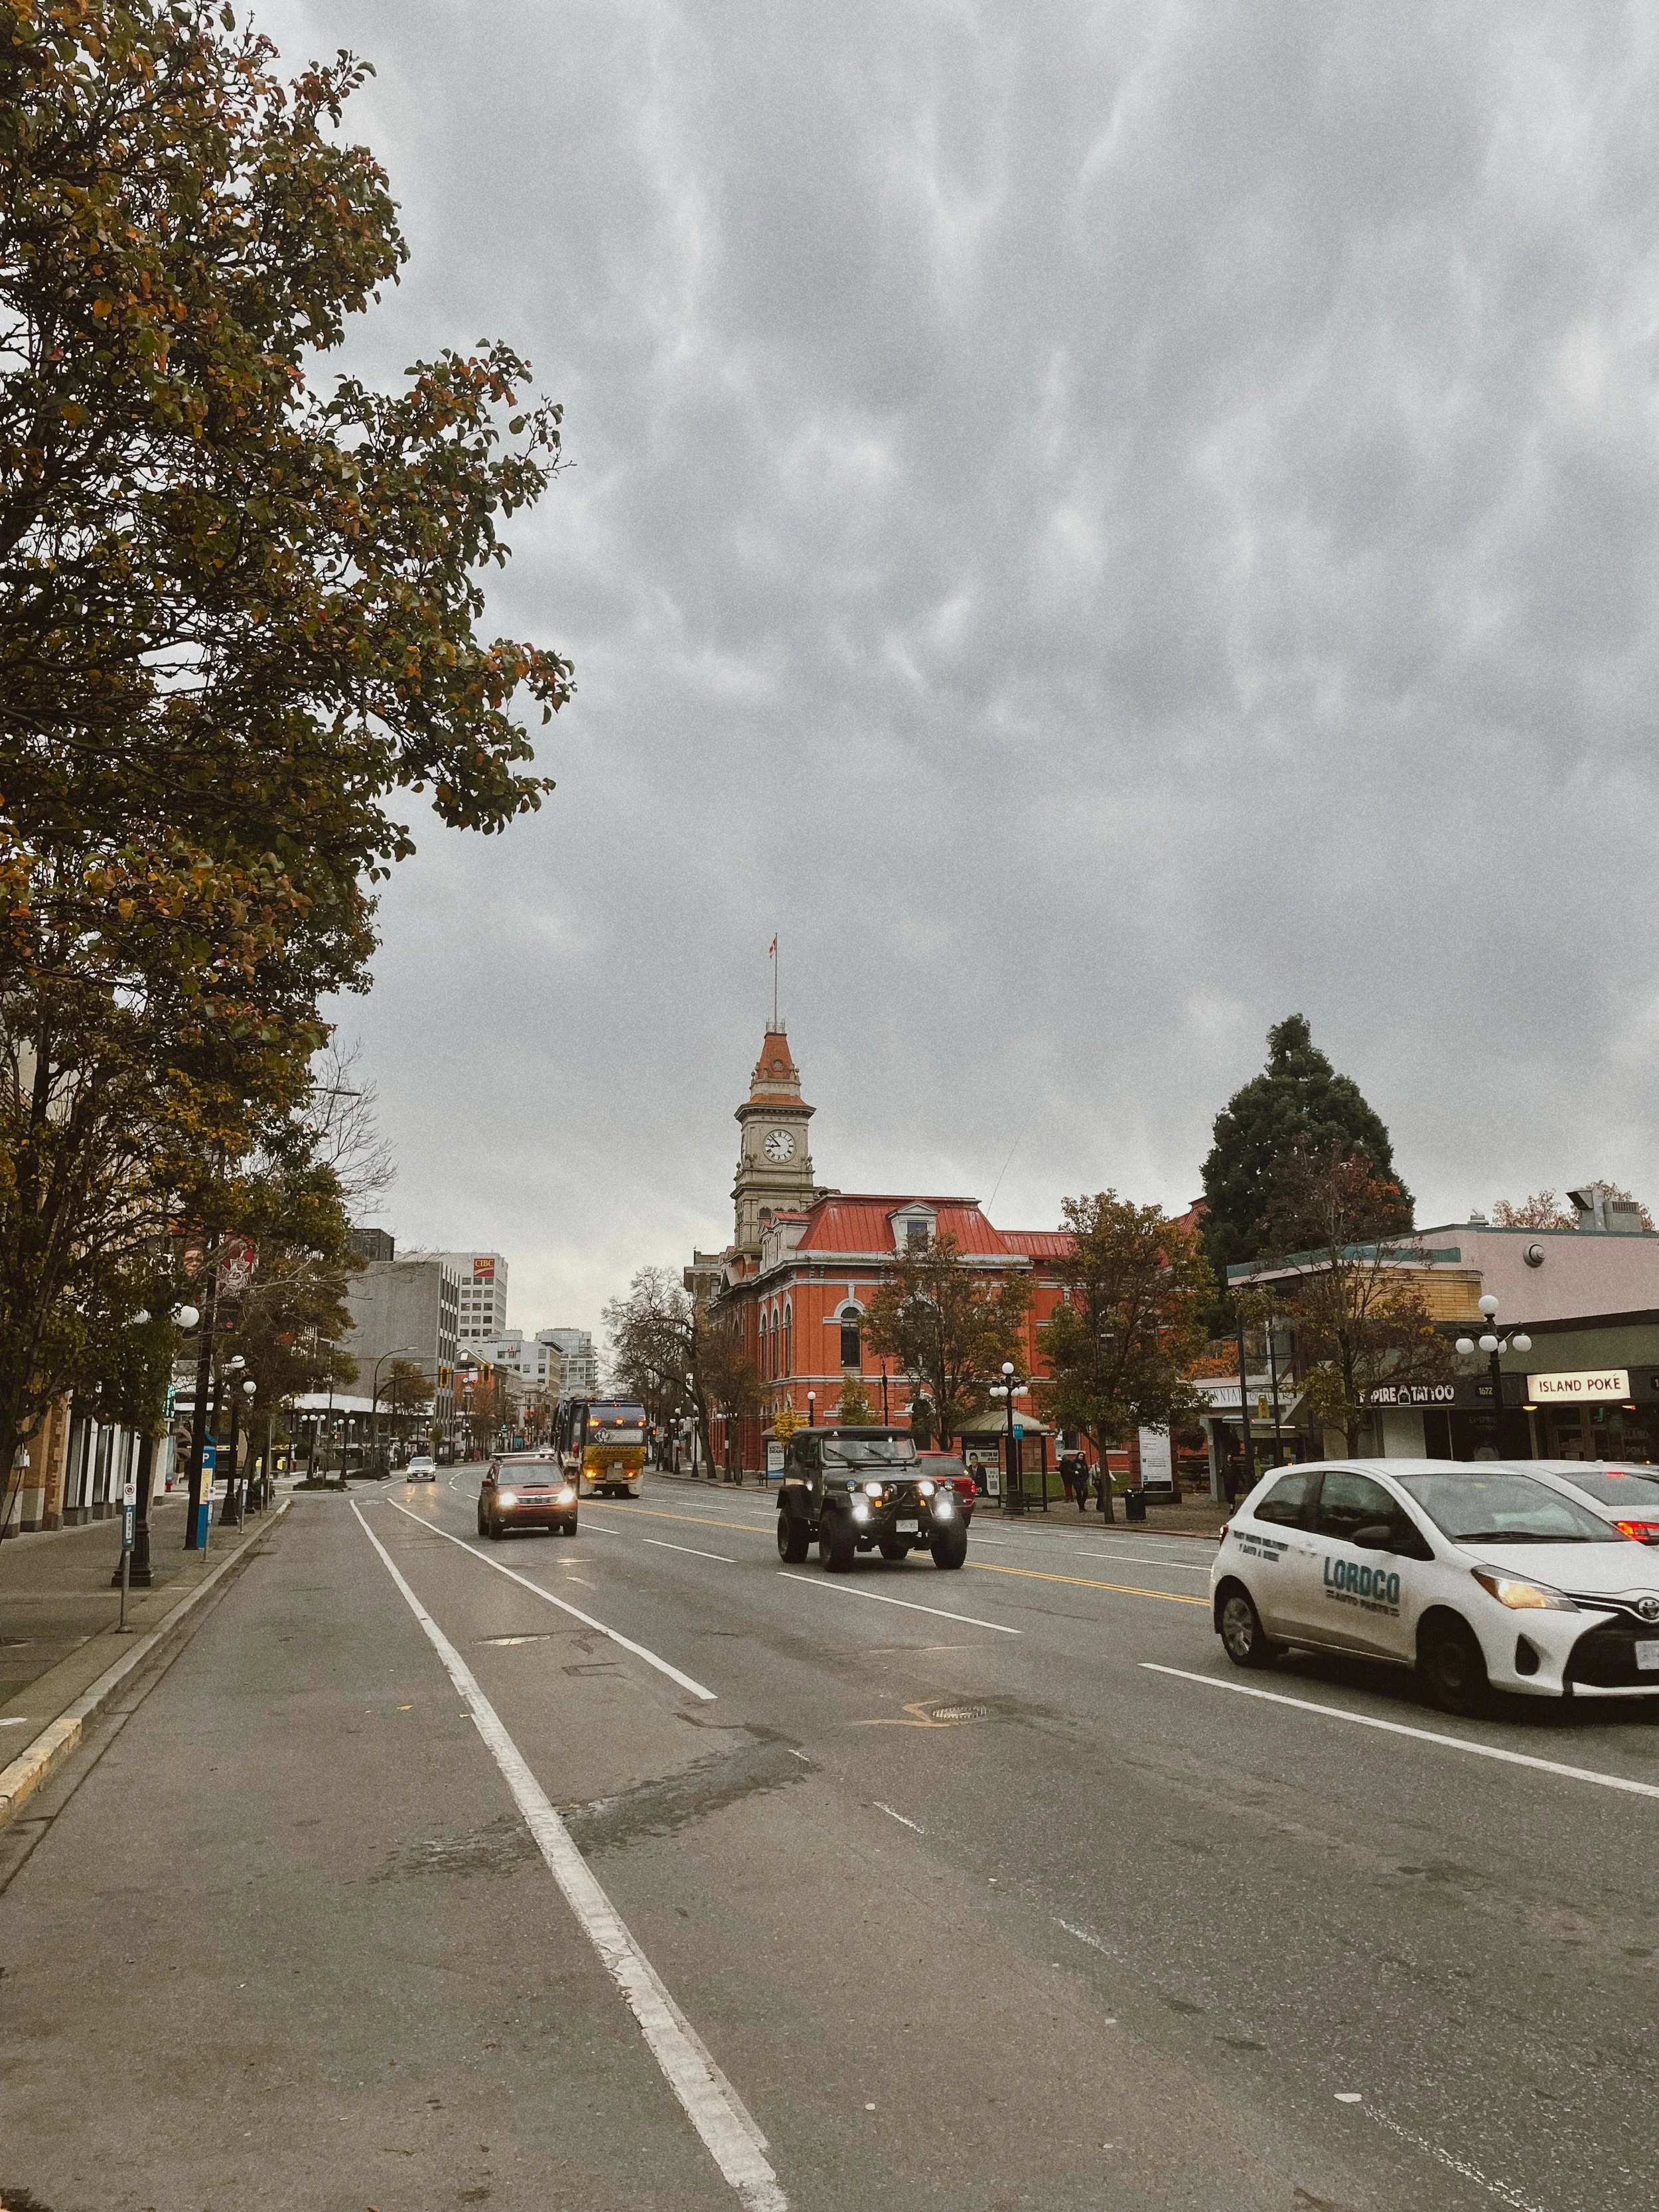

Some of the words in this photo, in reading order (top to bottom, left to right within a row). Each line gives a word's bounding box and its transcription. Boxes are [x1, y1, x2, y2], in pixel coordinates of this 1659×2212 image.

[1539, 1380, 1581, 1392] ISLAND
[1587, 1373, 1621, 1391] POKÉ
[1358, 1387, 1396, 1403] PIRE
[1411, 1385, 1454, 1401] TATTOO
[202, 1453, 209, 1463] P
[1324, 1557, 1400, 1604] LORDCO
